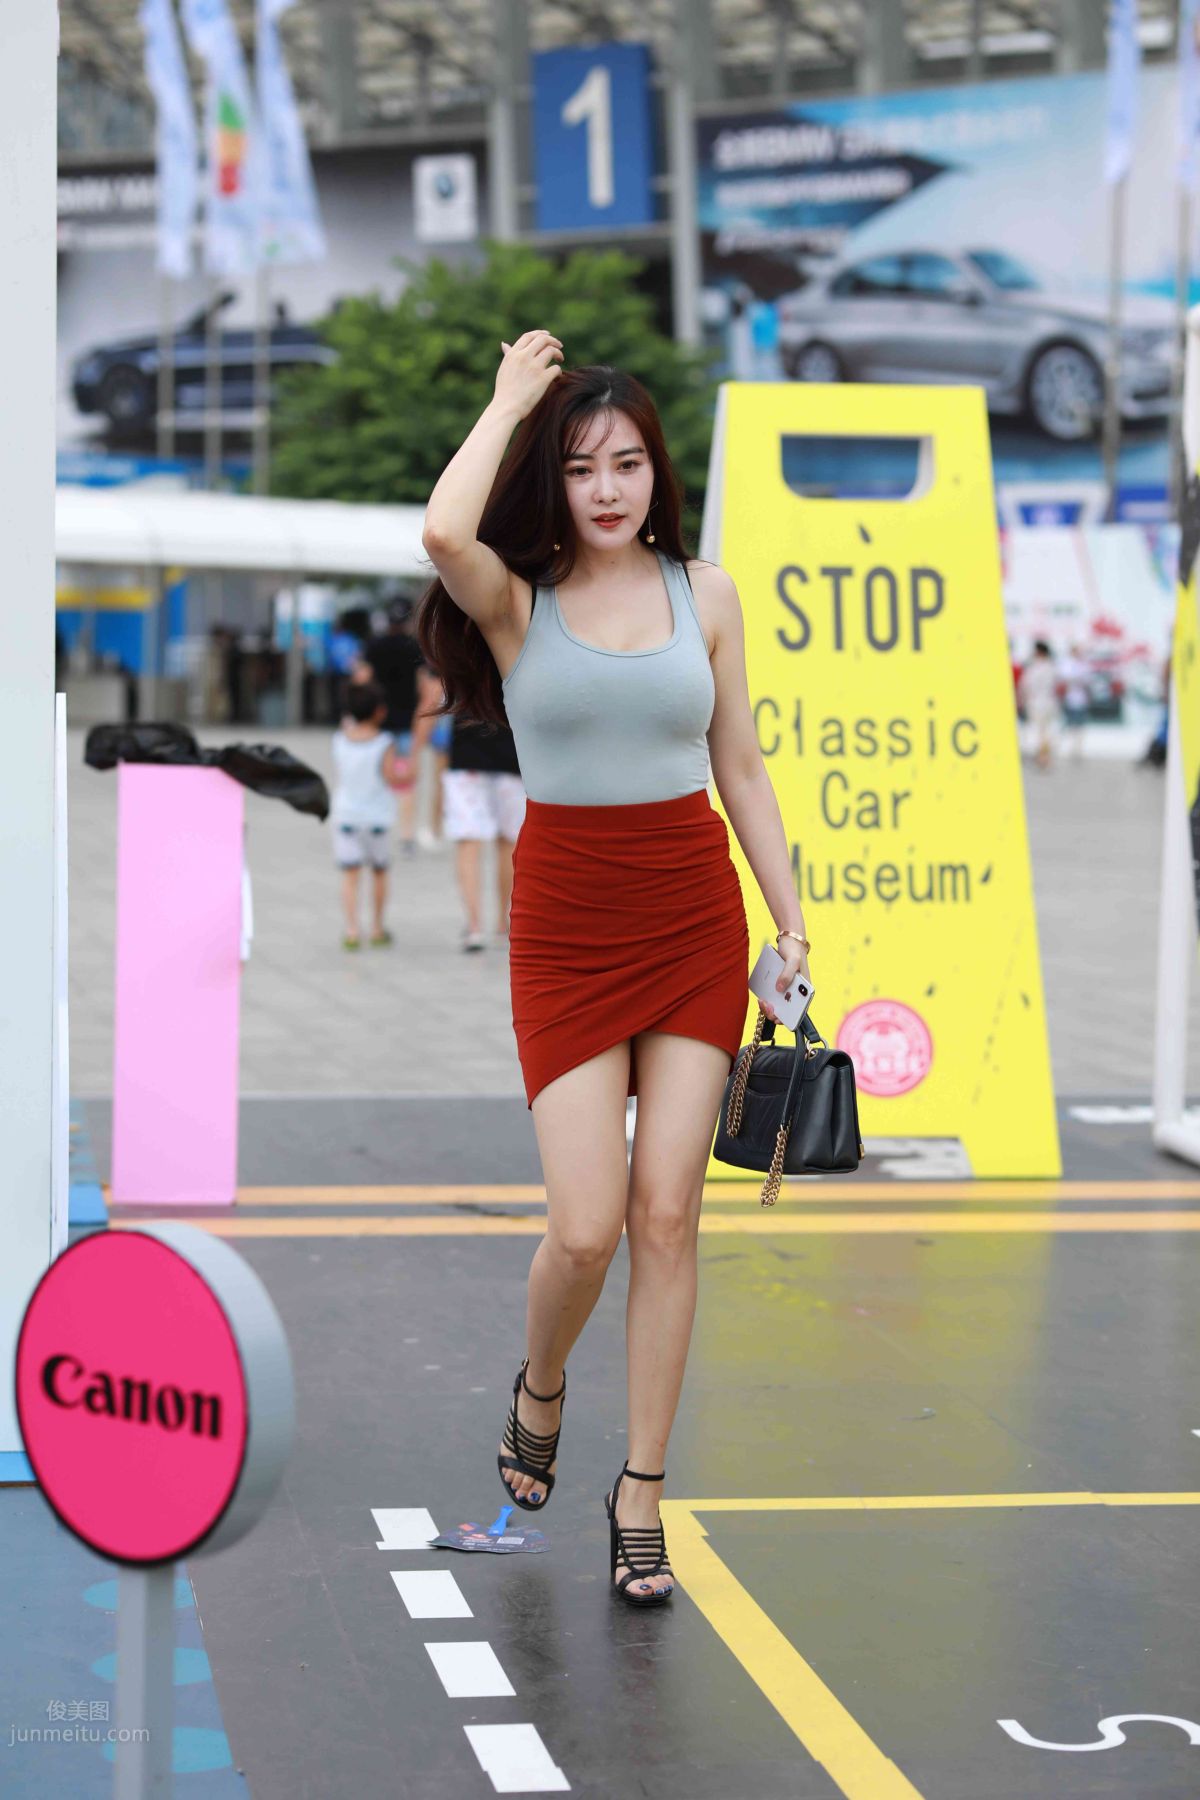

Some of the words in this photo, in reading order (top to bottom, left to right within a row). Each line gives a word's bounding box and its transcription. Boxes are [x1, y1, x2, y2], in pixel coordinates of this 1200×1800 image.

[562, 65, 614, 209] 1
[776, 564, 945, 652] STOP
[753, 698, 980, 758] Classic
[820, 769, 912, 831] Car
[41, 1354, 222, 1439] Canon
